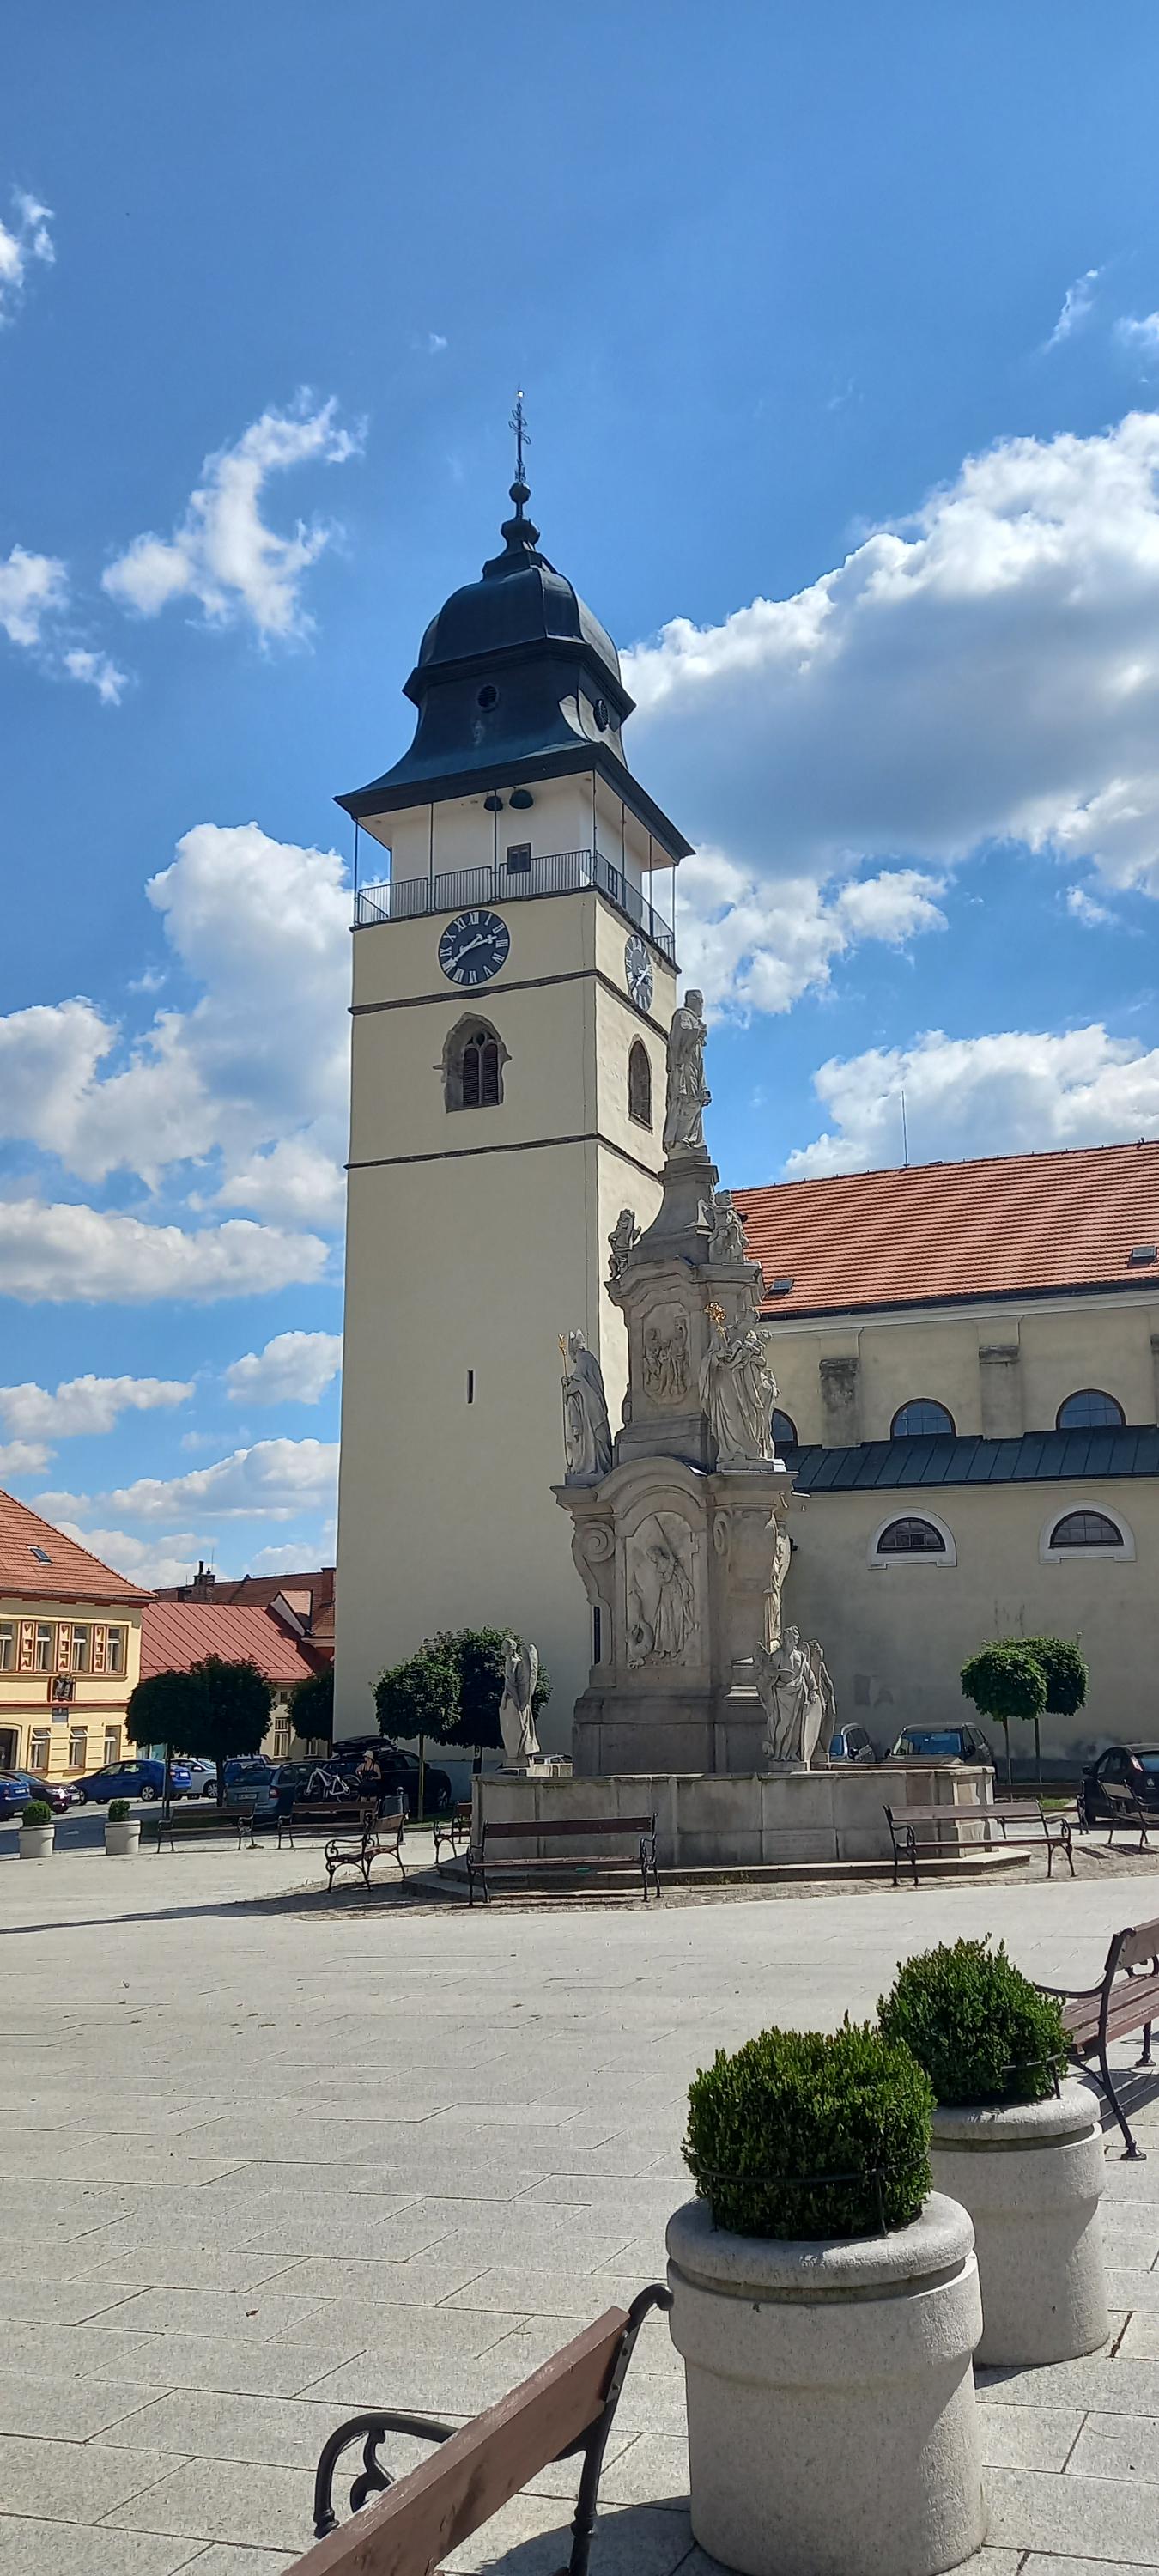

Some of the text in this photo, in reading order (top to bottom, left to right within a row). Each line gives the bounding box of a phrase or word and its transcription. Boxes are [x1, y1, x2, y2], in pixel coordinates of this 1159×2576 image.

[453, 917, 467, 932] XI
[484, 913, 493, 926] I
[443, 931, 456, 942] X
[495, 939, 508, 948] III
[483, 965, 494, 978] V
